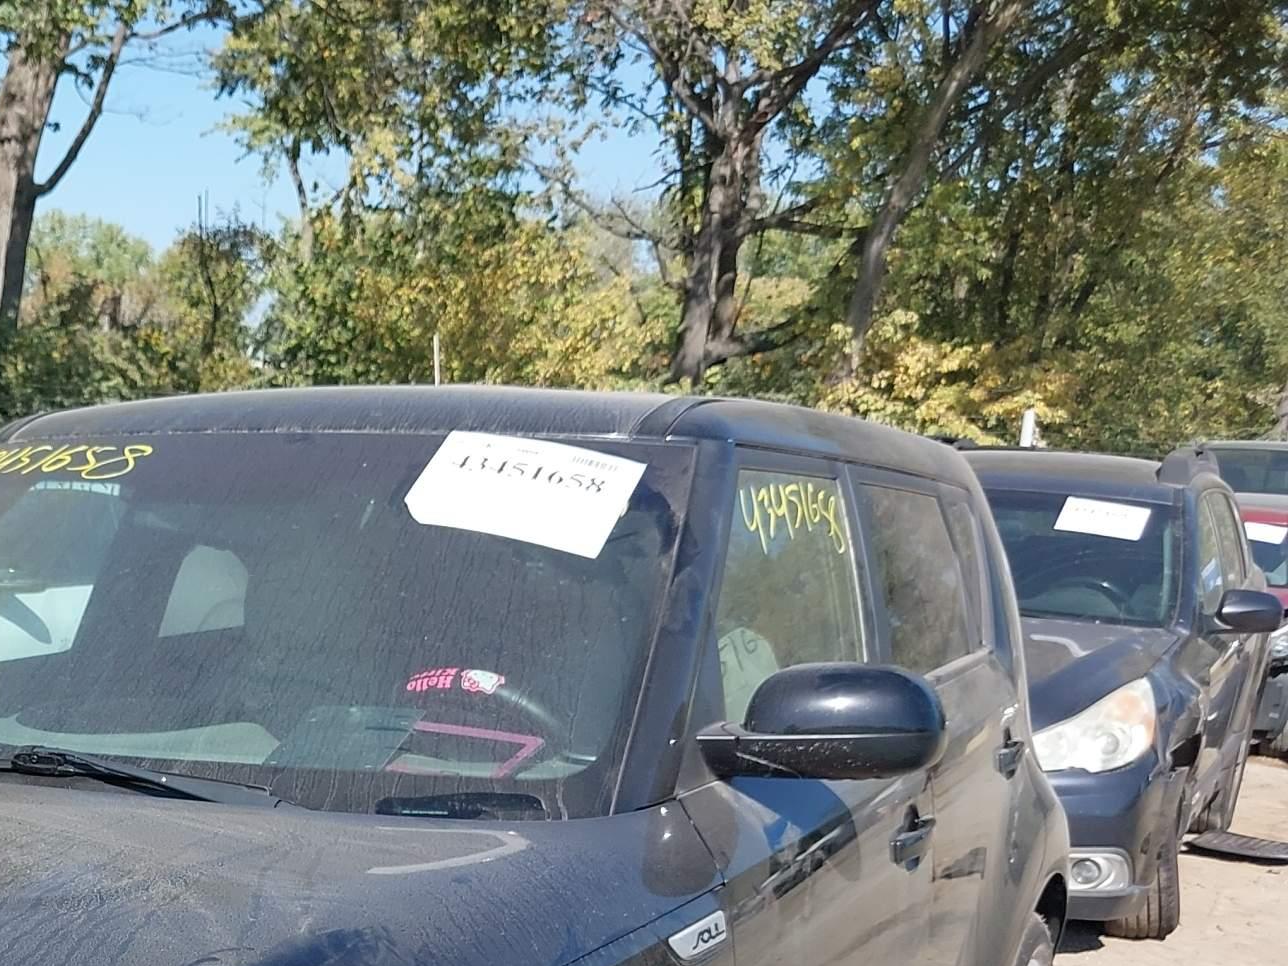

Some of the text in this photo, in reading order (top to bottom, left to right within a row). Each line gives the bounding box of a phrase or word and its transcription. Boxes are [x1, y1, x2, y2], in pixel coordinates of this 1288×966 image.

[453, 454, 607, 494] 43451658
[739, 481, 845, 555] 43451658
[406, 675, 454, 692] Hello
